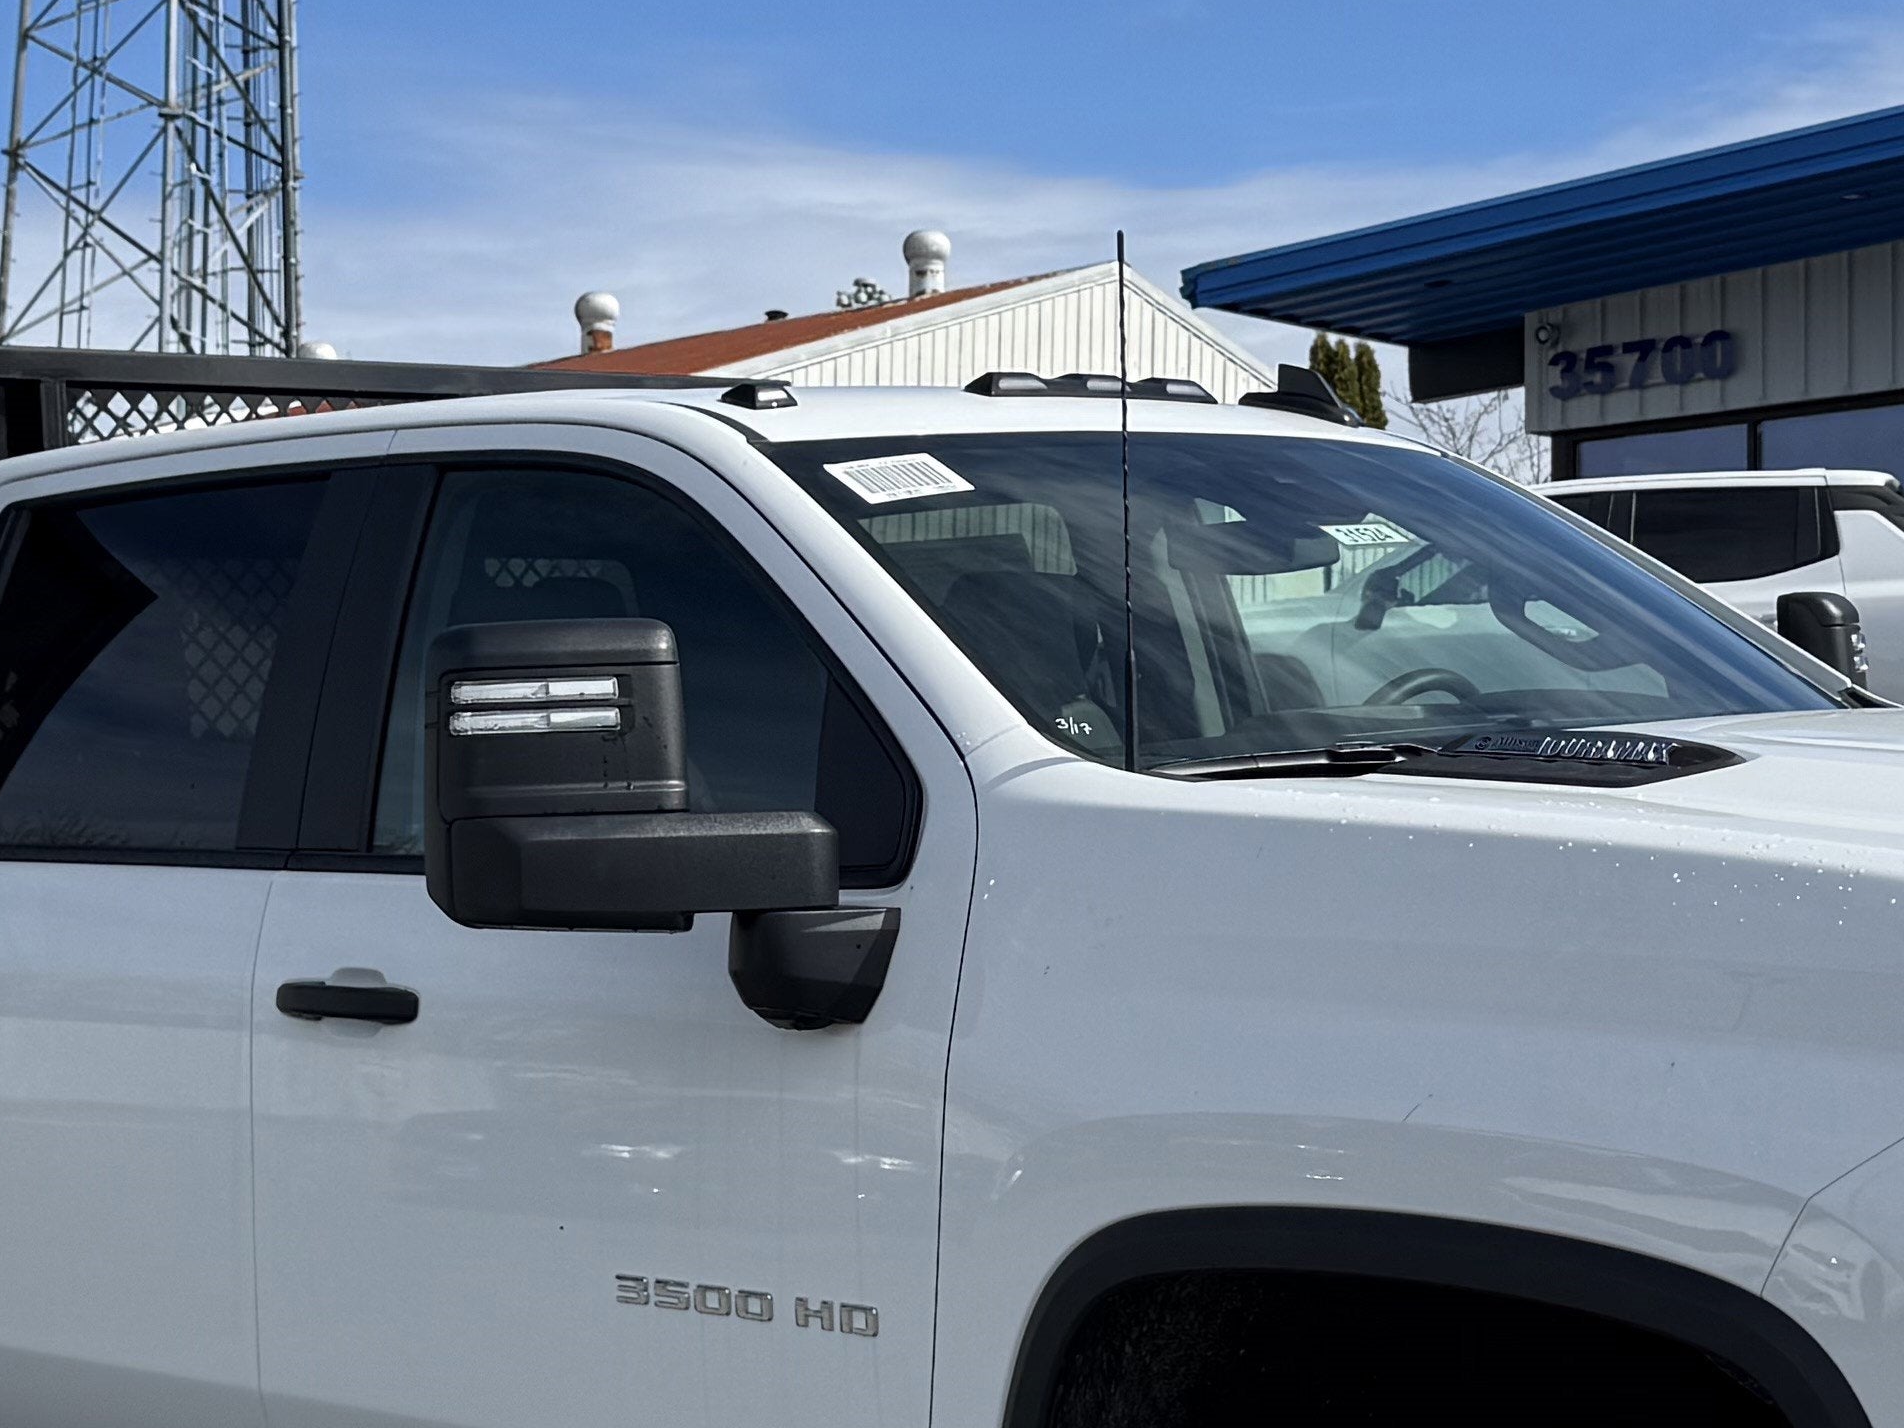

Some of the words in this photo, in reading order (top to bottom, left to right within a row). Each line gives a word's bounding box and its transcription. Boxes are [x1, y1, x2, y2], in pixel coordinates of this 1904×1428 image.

[1548, 330, 1737, 401] 35700
[1055, 716, 1093, 735] 3/17
[615, 1273, 775, 1323] 3500
[795, 1296, 880, 1338] HD
